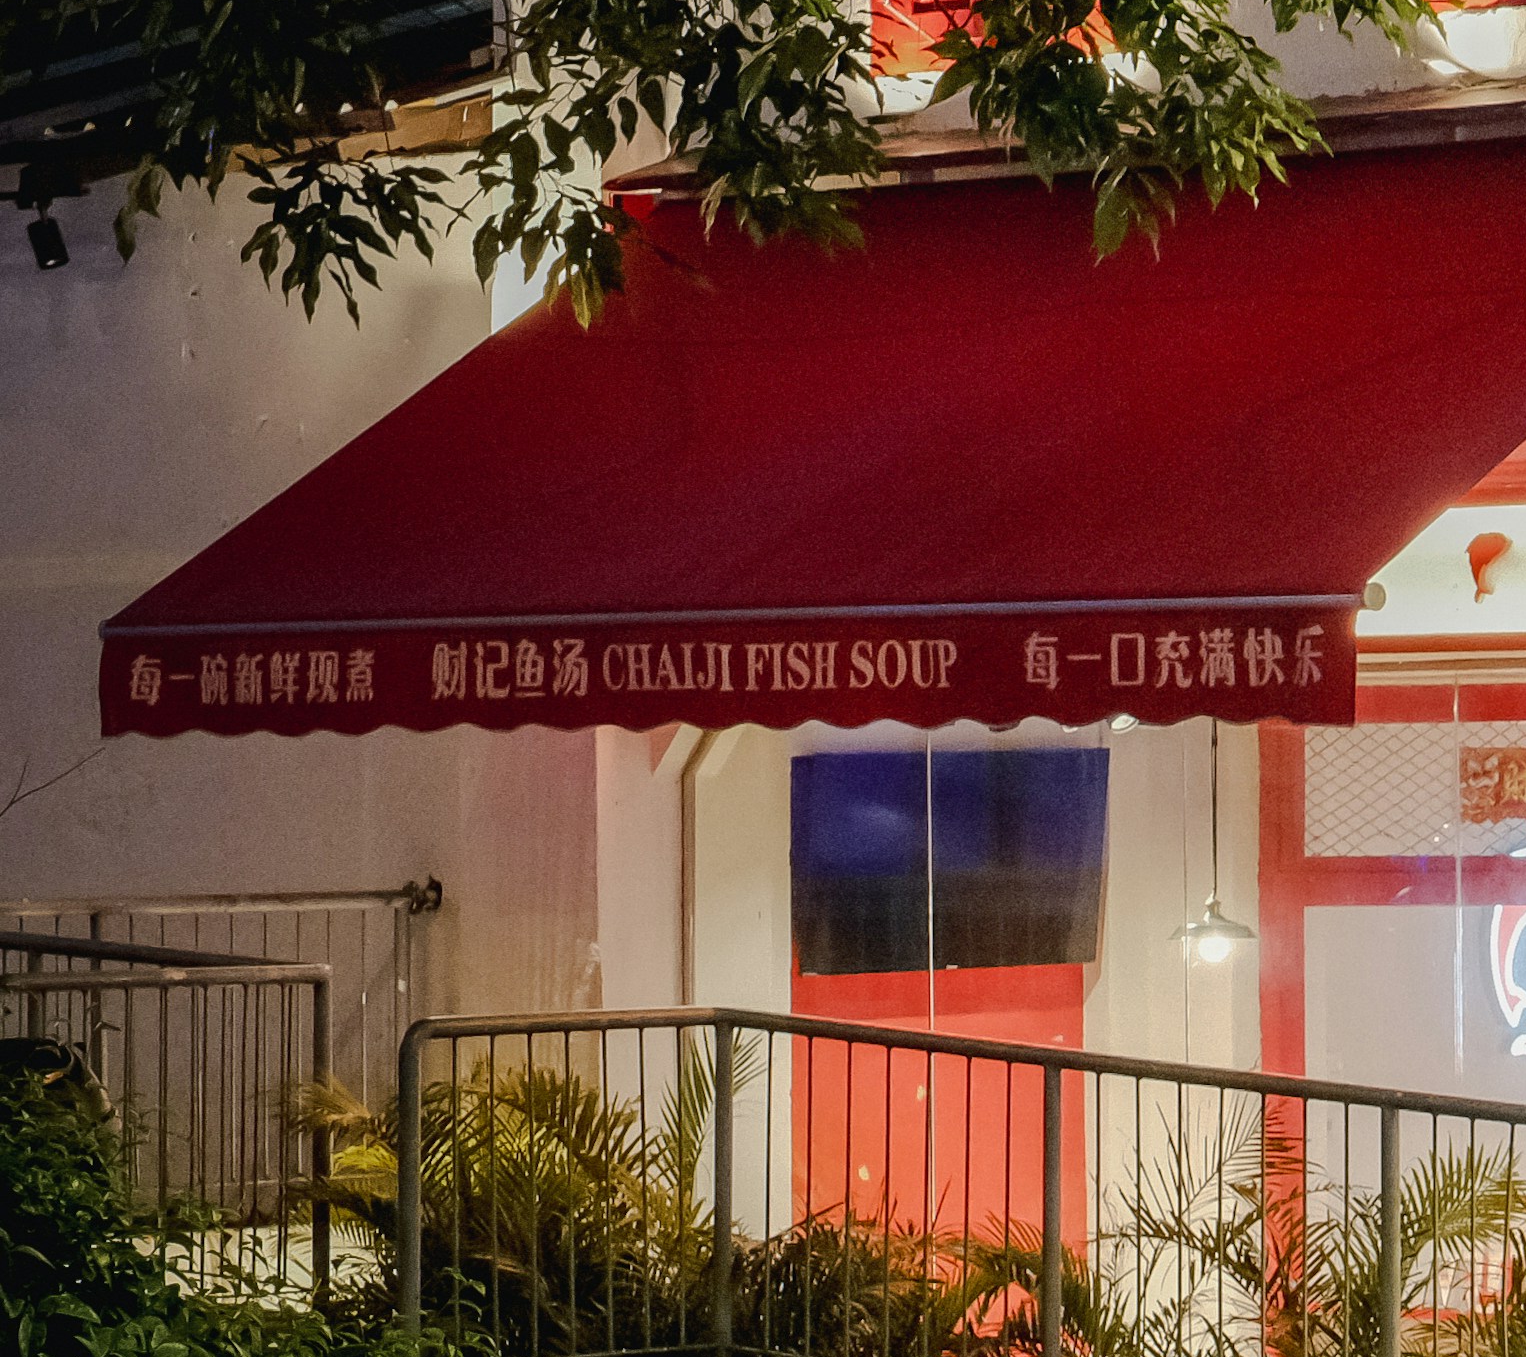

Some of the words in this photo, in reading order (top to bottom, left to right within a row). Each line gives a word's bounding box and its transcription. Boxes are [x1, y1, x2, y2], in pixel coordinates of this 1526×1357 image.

[129, 649, 376, 706] 每一碗新鲜现煮
[430, 638, 588, 700] 财记鱼汤
[603, 642, 735, 692] CHAIJI
[744, 641, 837, 692] FISH
[849, 639, 958, 689] SOUP
[1024, 624, 1325, 691] 每一口充满快乐
